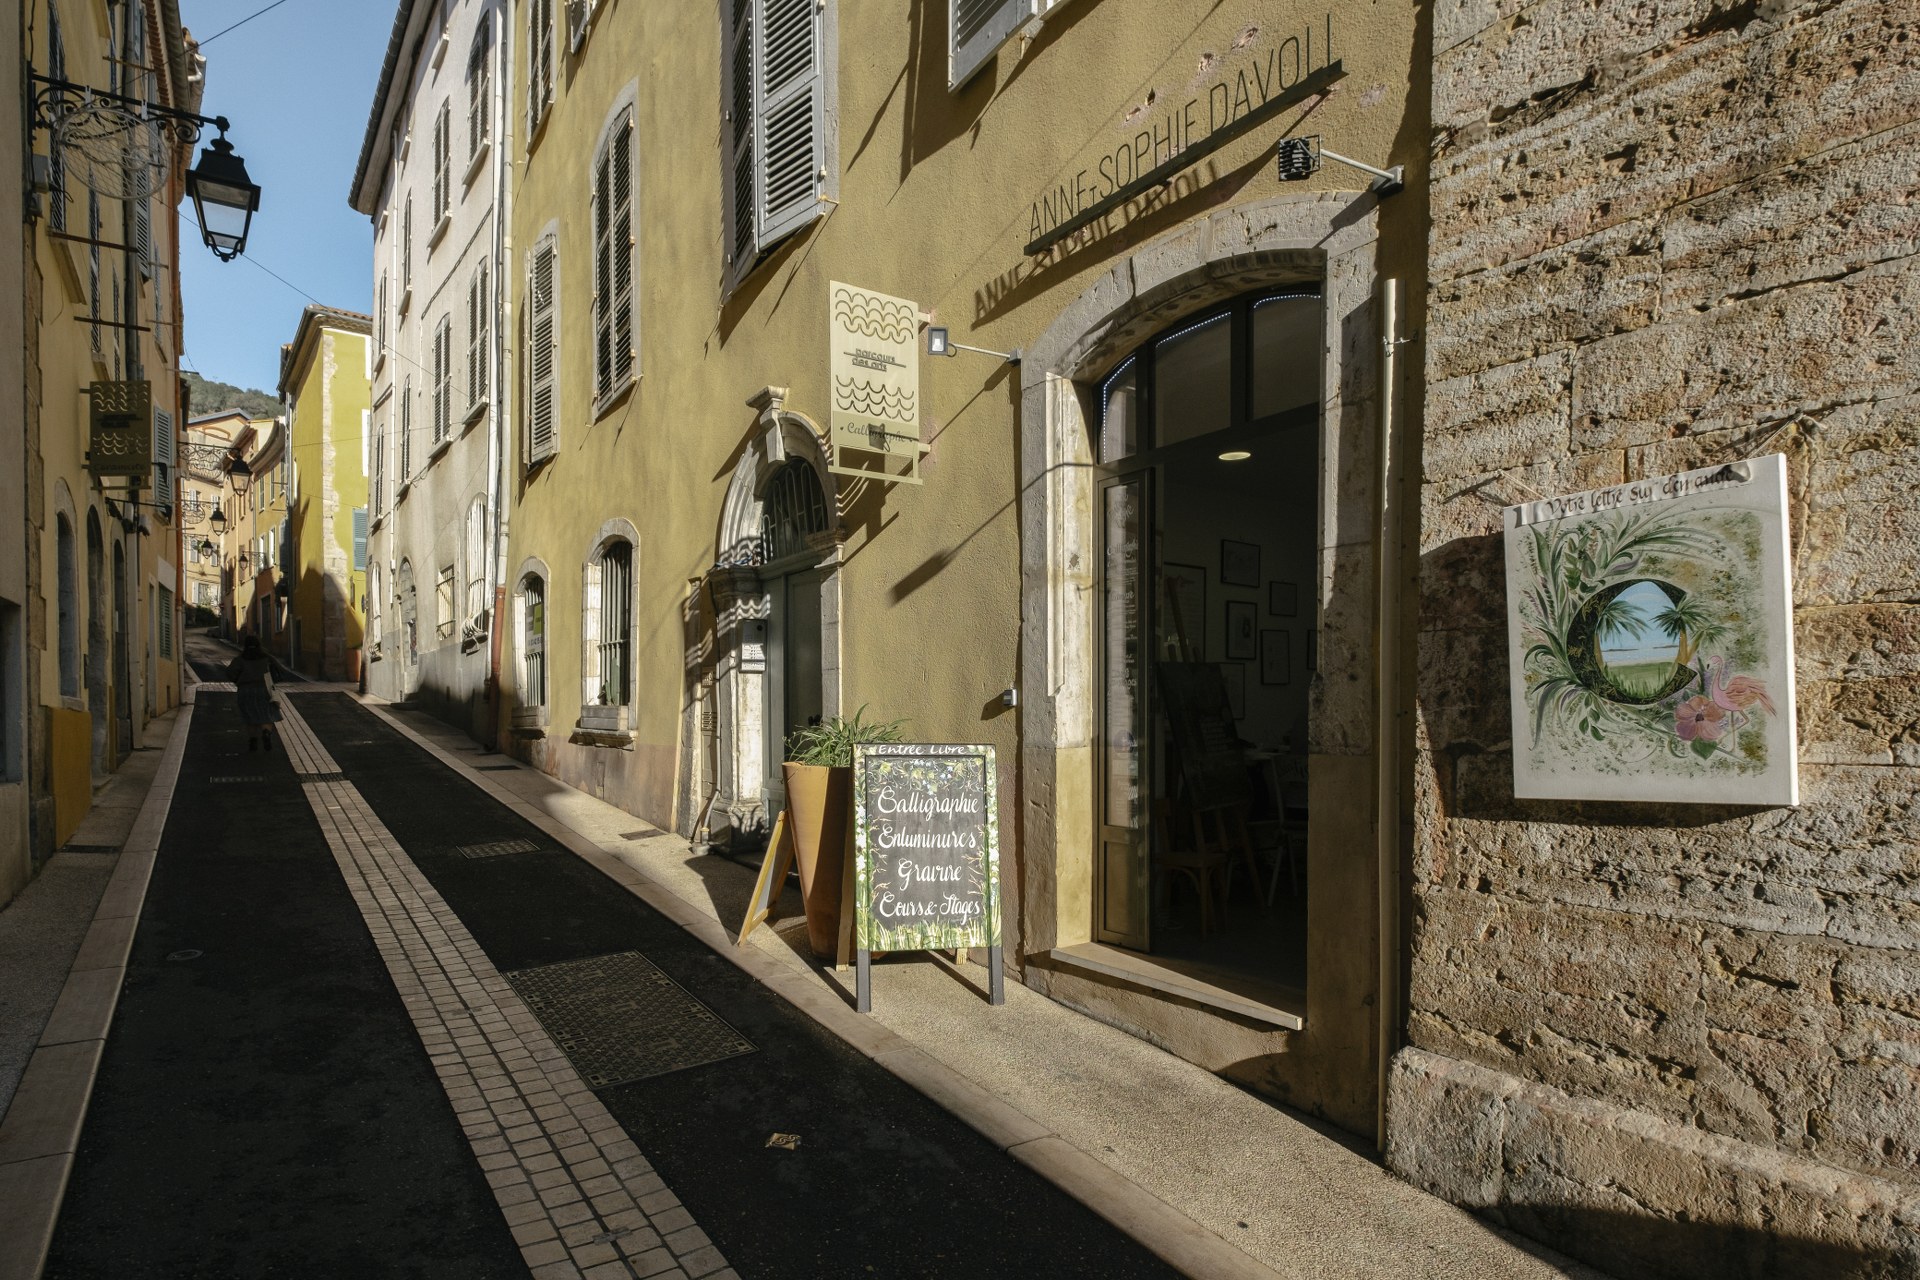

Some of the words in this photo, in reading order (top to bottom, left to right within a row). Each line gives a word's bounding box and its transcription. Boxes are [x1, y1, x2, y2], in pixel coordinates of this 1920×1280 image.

[1210, 13, 1332, 137] DAVOLI
[1546, 498, 1586, 515] Votre
[1591, 487, 1623, 509] lettre
[1629, 482, 1658, 502] sur
[878, 744, 924, 755] Entrée
[930, 744, 967, 755] Libre
[877, 785, 980, 821] Calligraphie
[878, 823, 976, 849] Enluminures
[898, 858, 963, 891] Gravure
[879, 891, 924, 918] Cours
[924, 904, 938, 916] &
[939, 892, 981, 926] Stages
